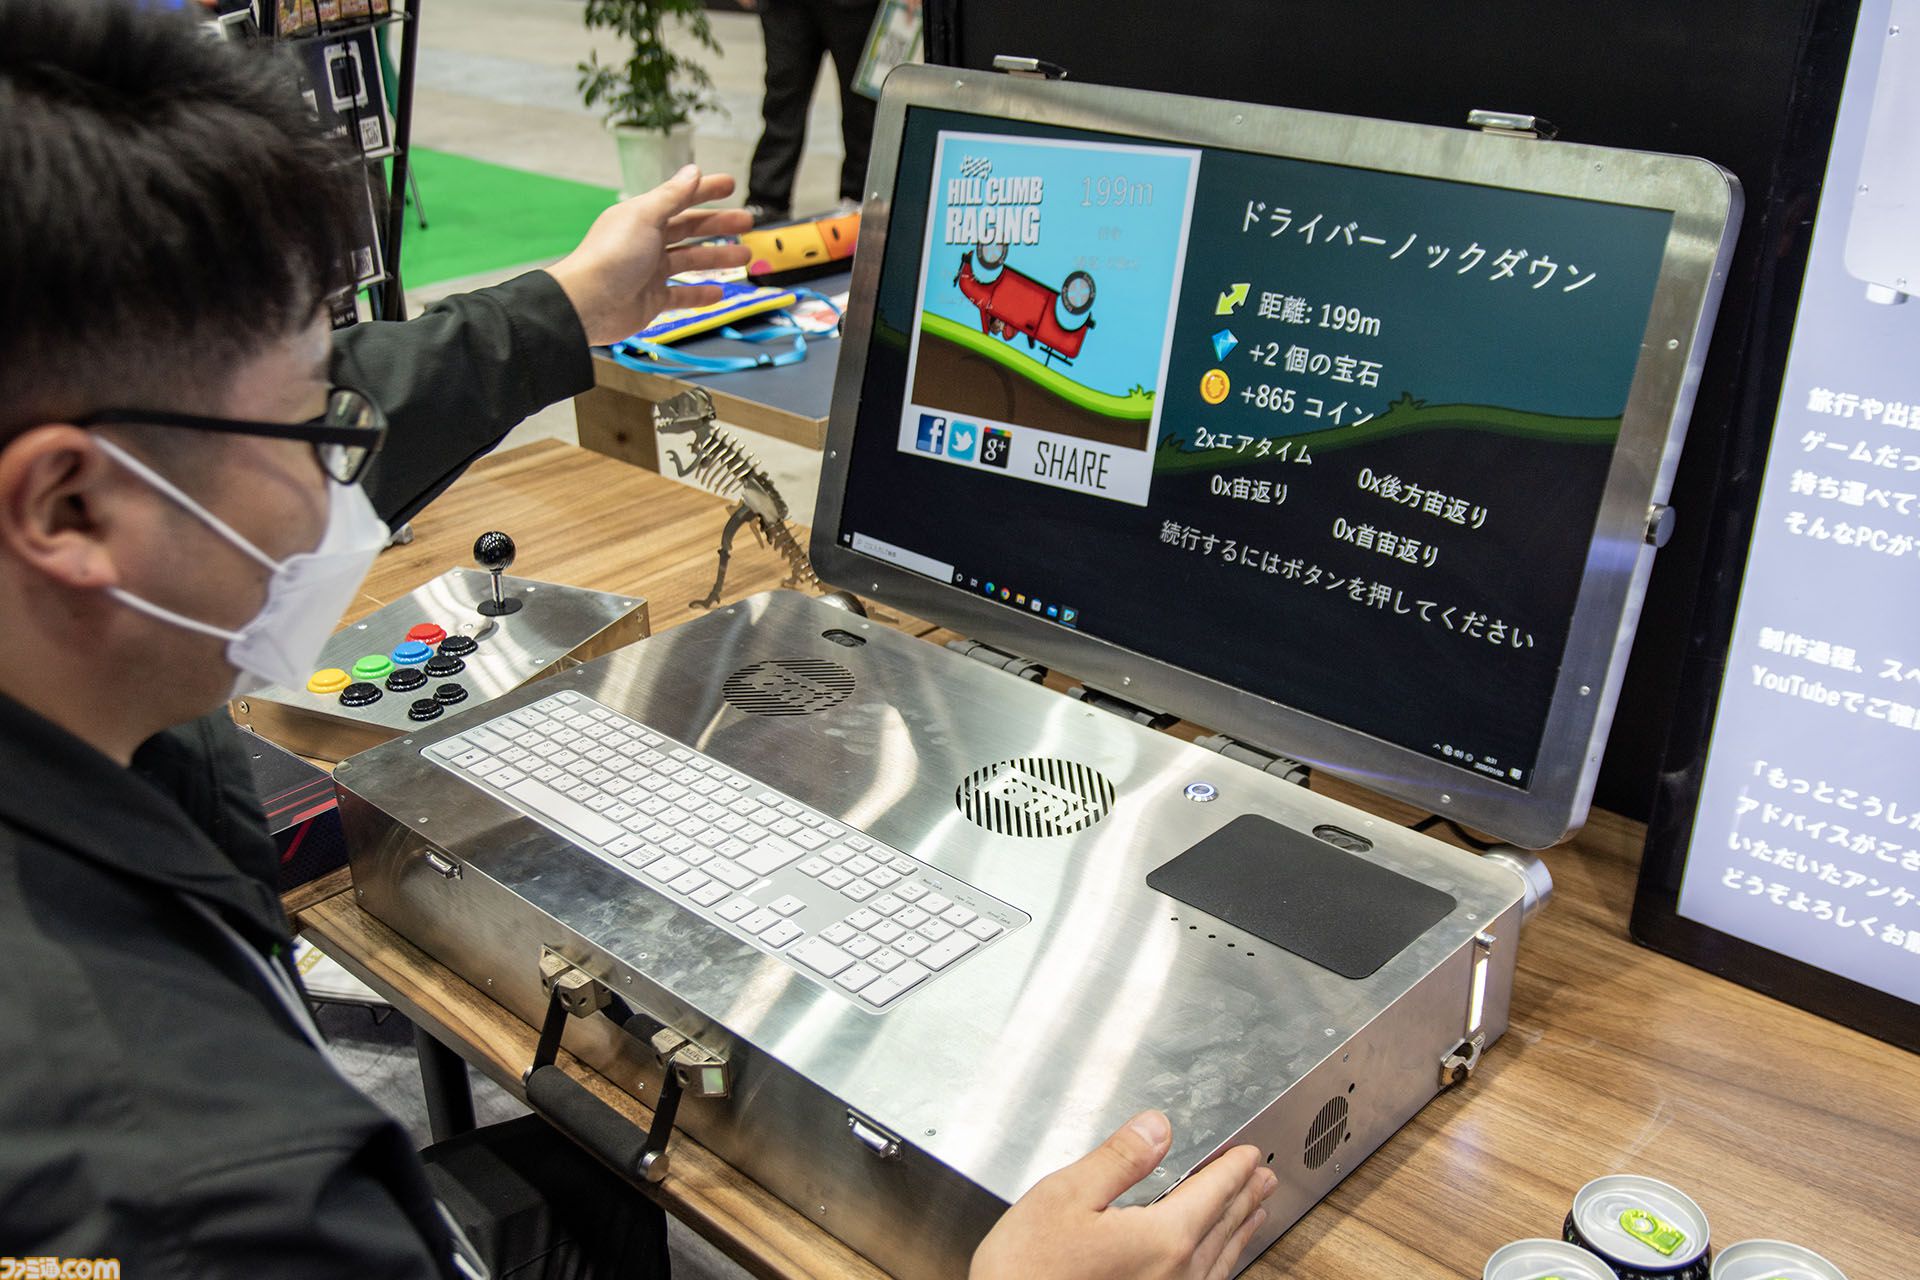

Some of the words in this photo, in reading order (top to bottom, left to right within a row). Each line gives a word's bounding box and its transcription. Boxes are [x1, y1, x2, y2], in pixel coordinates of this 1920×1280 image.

[947, 177, 983, 206] HILL
[985, 175, 1043, 206] CLIMB
[1080, 175, 1154, 208] 199m
[944, 206, 1042, 246] RACING
[1242, 200, 1597, 292] ドライバーノックダウン
[1319, 304, 1381, 337] 199m
[1285, 345, 1383, 388] 個の宝石
[1240, 384, 1295, 414] +865
[1304, 397, 1375, 428] コイン
[1034, 440, 1111, 490] SHARE
[1195, 427, 1313, 465] 2xエアタイム
[1211, 474, 1289, 506] 0x宙返り
[1358, 468, 1488, 530] 0x後方宙返り
[1790, 469, 1920, 517] 持ち運べて
[1333, 518, 1440, 568] 0x首宙返り
[1784, 511, 1920, 559] そんなPCが
[1160, 519, 1535, 650] 続行するにはボタンを押してください
[1728, 832, 1920, 907] いただいたアンケ
